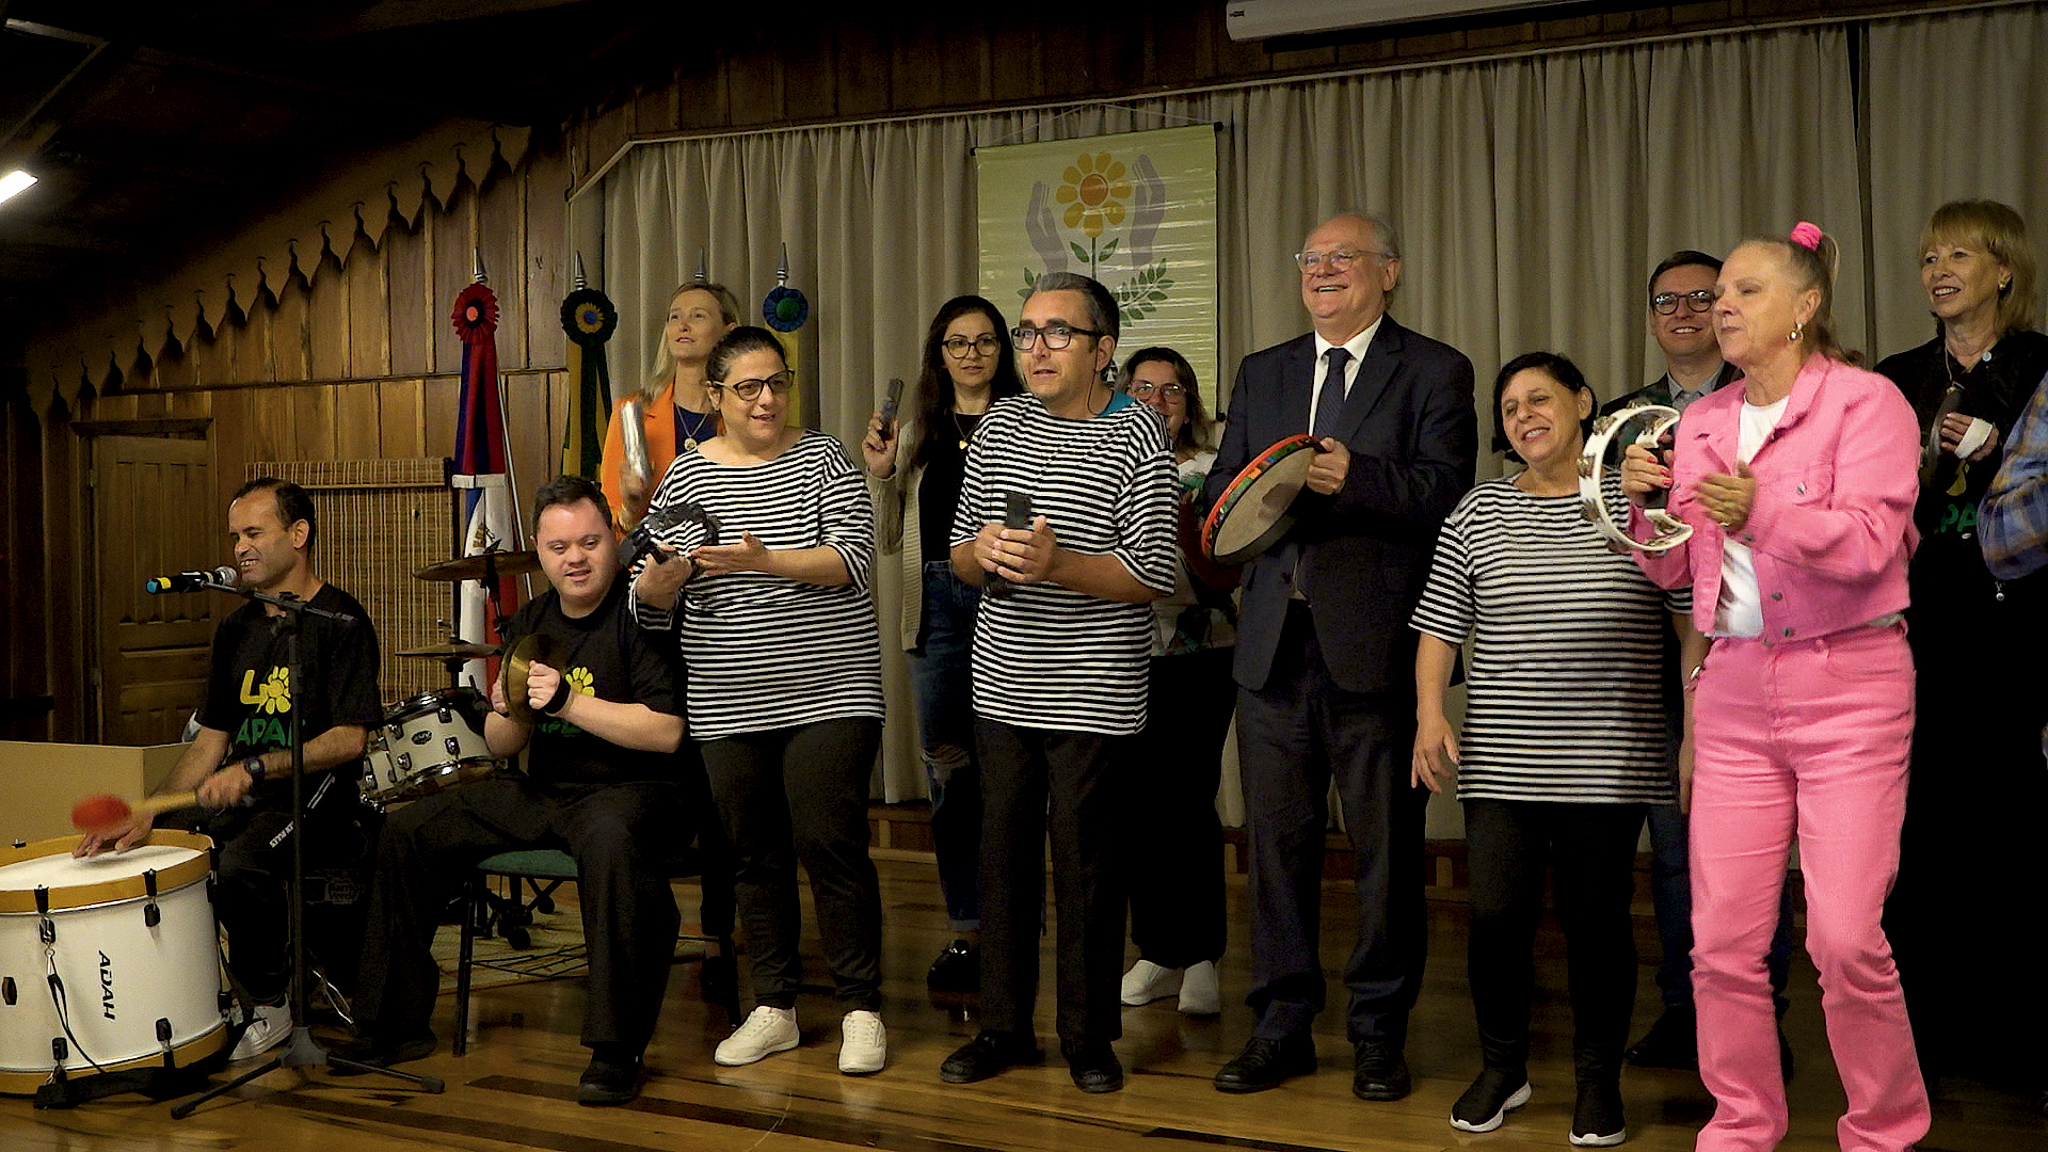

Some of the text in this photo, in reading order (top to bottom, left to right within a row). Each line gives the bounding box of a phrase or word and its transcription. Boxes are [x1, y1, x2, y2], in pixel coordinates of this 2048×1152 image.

[1934, 502, 1978, 533] PA
[236, 718, 305, 747] APA
[98, 949, 116, 1021] ADAH
